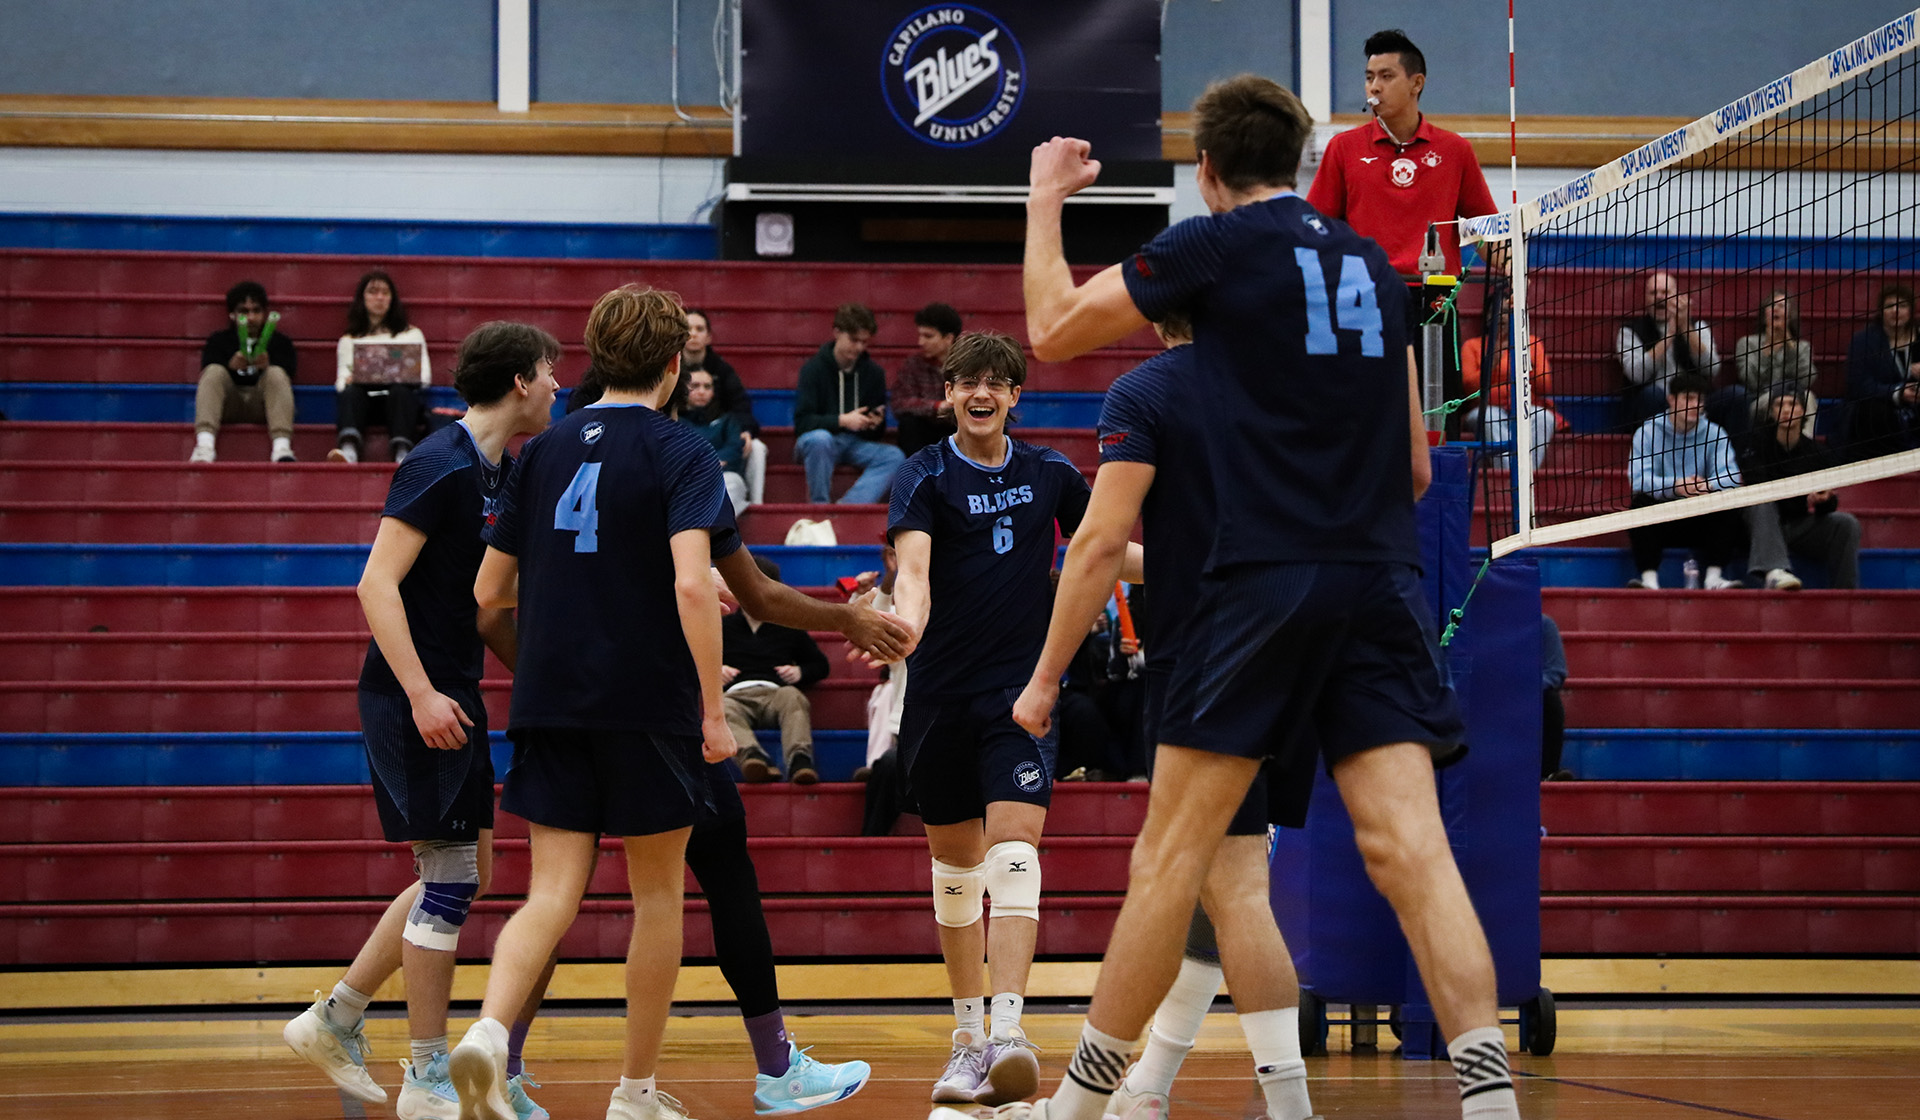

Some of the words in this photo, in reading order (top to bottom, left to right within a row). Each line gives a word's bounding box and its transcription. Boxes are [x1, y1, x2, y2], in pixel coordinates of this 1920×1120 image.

[888, 9, 965, 66] CAPILANO
[904, 28, 999, 127] Blues
[929, 69, 1020, 141] UNIVERSITY
[1294, 247, 1385, 358] 14
[554, 462, 602, 553] 4
[967, 485, 1034, 515] BLUES
[992, 515, 1014, 555] 6
